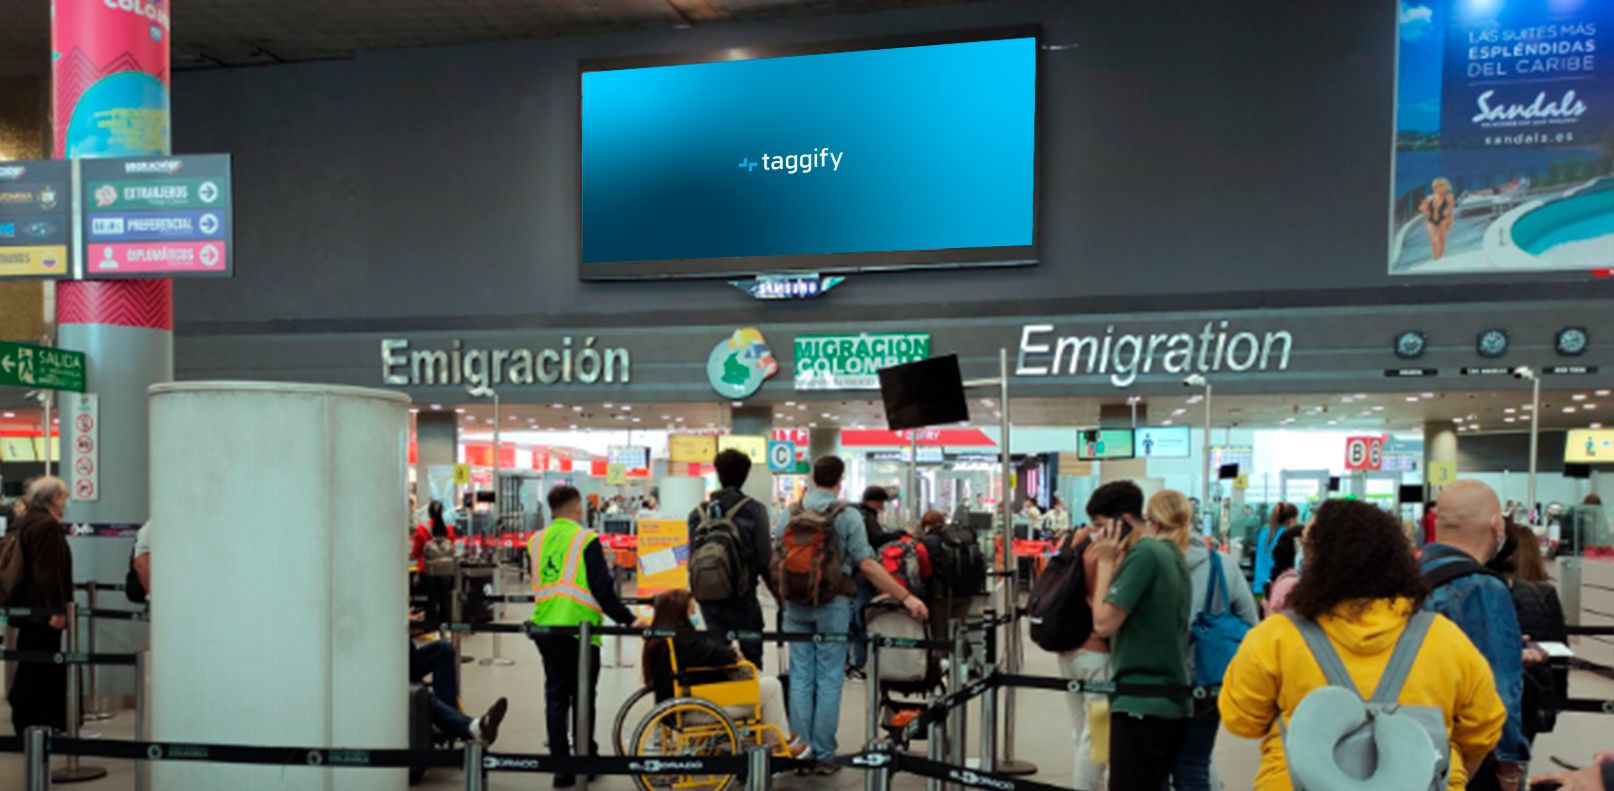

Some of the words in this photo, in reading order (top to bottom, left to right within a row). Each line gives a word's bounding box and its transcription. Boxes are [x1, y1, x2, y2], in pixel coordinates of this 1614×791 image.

[1468, 29, 1499, 44] LAS
[1502, 24, 1557, 41] SUITES
[1560, 21, 1597, 36] MÁS
[1468, 38, 1597, 61] ESPLÉNDIDAS
[1467, 61, 1507, 78] DEL
[1515, 55, 1595, 74] CARIBE
[1471, 89, 1588, 122] Sandals
[1484, 131, 1573, 145] sandals.es
[761, 147, 843, 174] taggify
[124, 185, 188, 200] EXTRANJEROS
[38, 350, 81, 368] SALIDA
[381, 336, 630, 394] Emigración
[1016, 320, 1293, 387] Emigration
[776, 446, 787, 464] C
